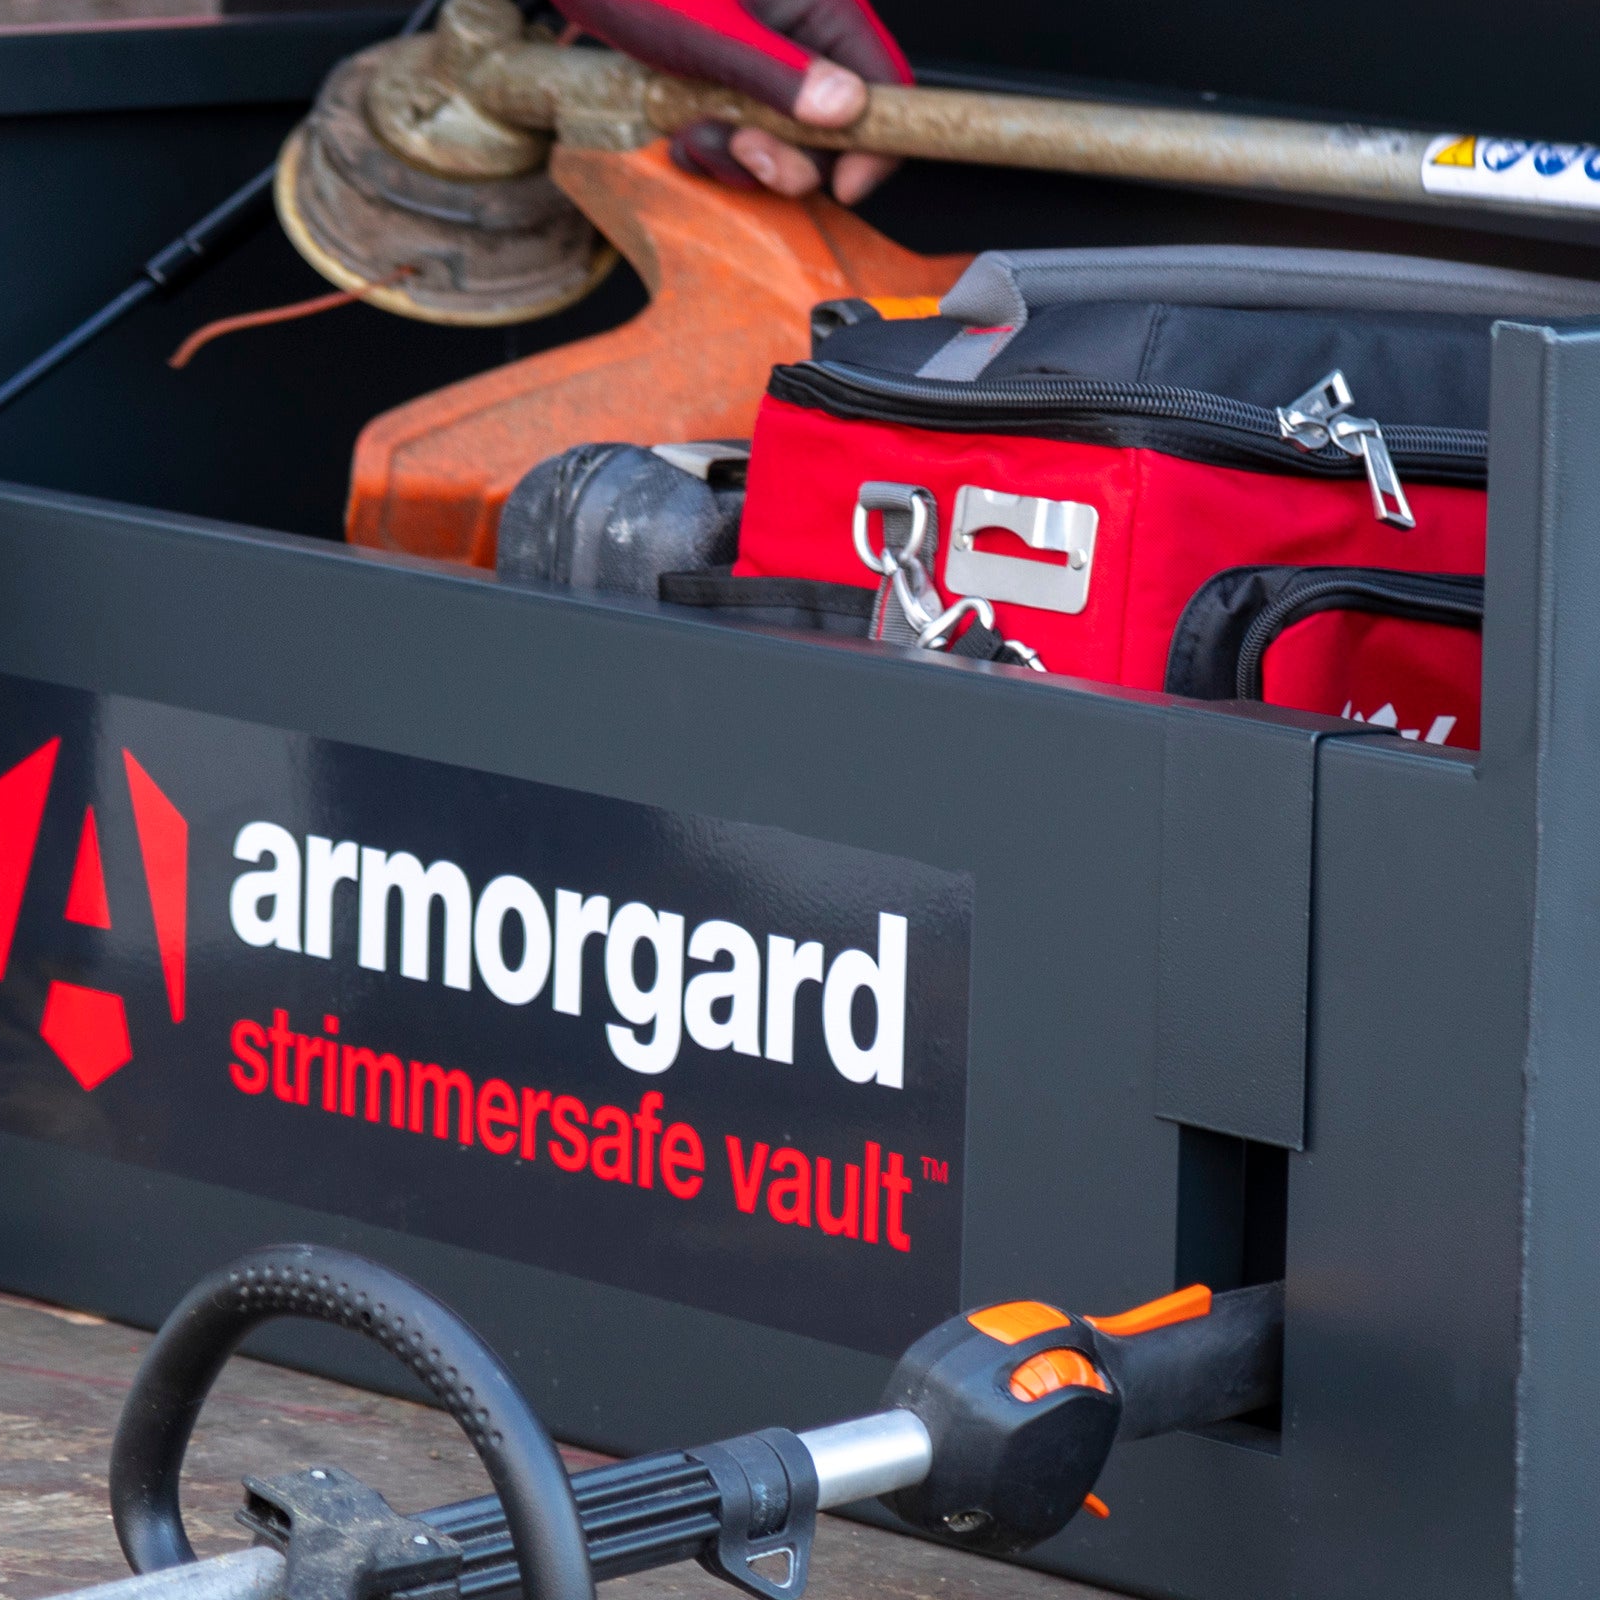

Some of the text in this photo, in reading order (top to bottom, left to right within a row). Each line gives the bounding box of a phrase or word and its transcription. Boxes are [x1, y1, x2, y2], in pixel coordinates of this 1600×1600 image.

[229, 821, 909, 1088] armorgard
[228, 1007, 706, 1201] strimmersafe
[724, 1133, 913, 1253] vault
